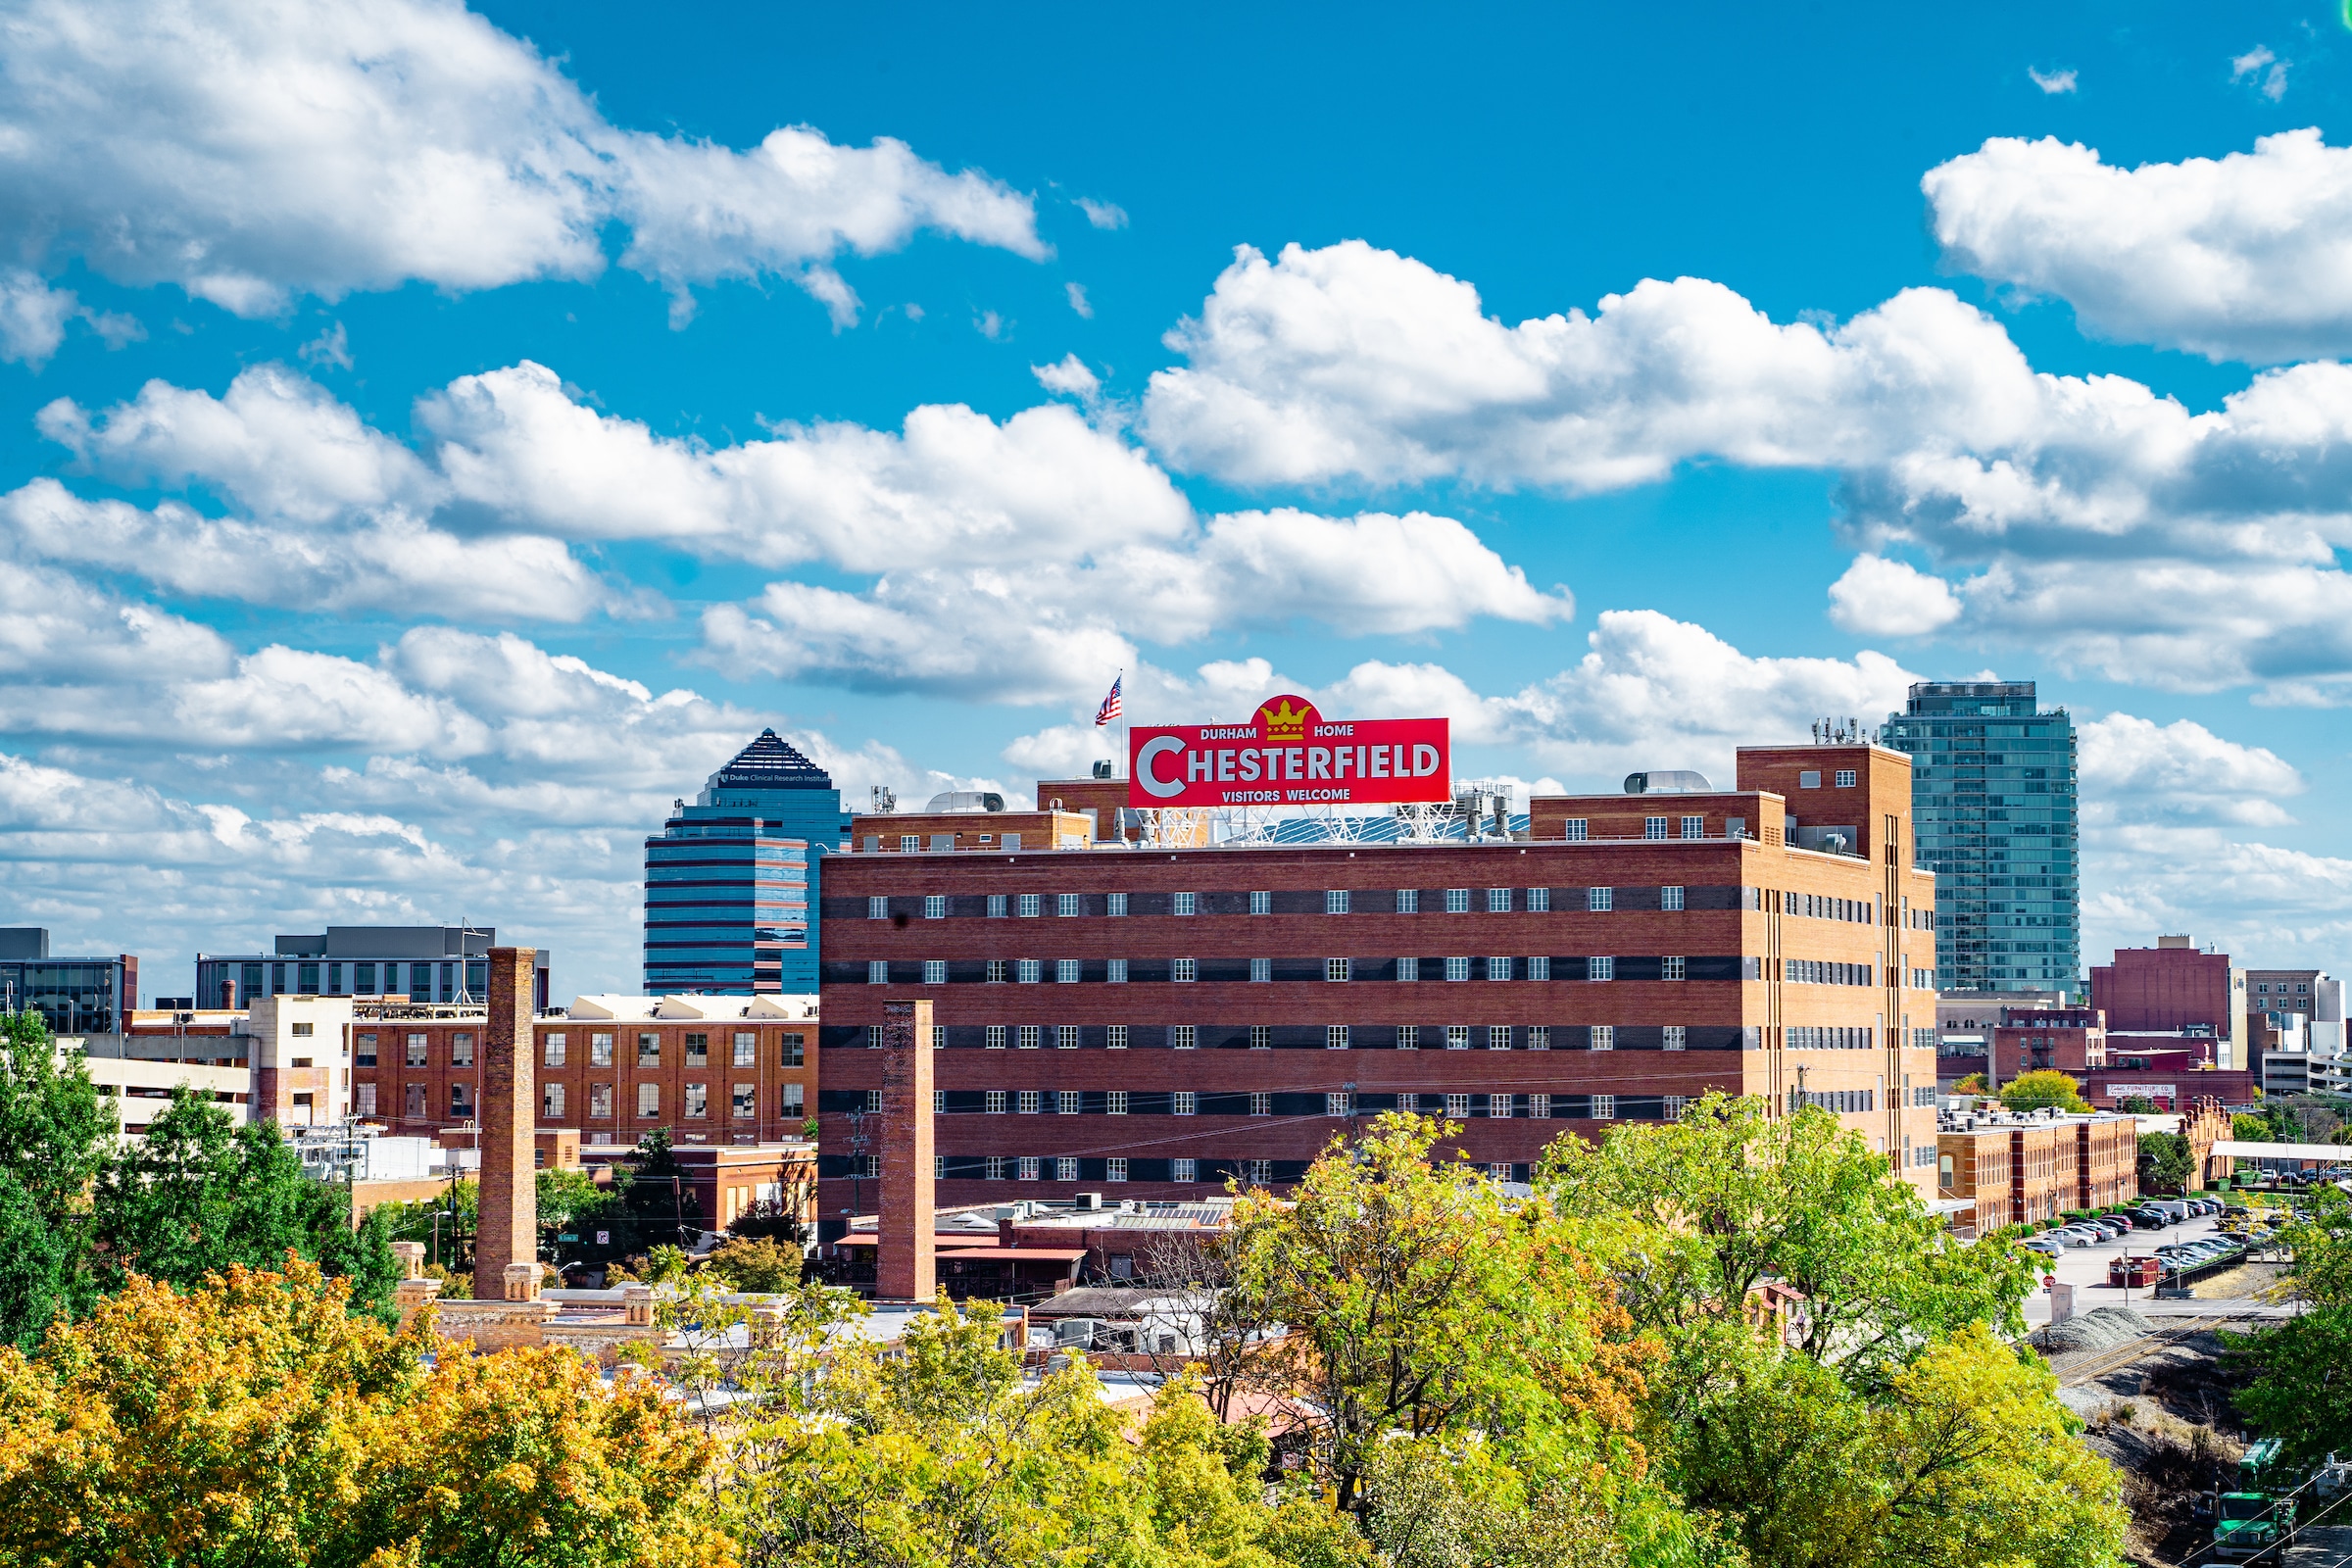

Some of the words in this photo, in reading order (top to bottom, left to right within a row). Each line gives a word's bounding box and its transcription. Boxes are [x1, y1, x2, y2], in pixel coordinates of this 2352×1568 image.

[1200, 727, 1256, 740] DURHAM
[1314, 725, 1354, 737] HOME
[1136, 735, 1440, 799] CHESTERFIELD
[1222, 790, 1280, 803] VISITORS
[1287, 788, 1350, 801] WELCOME
